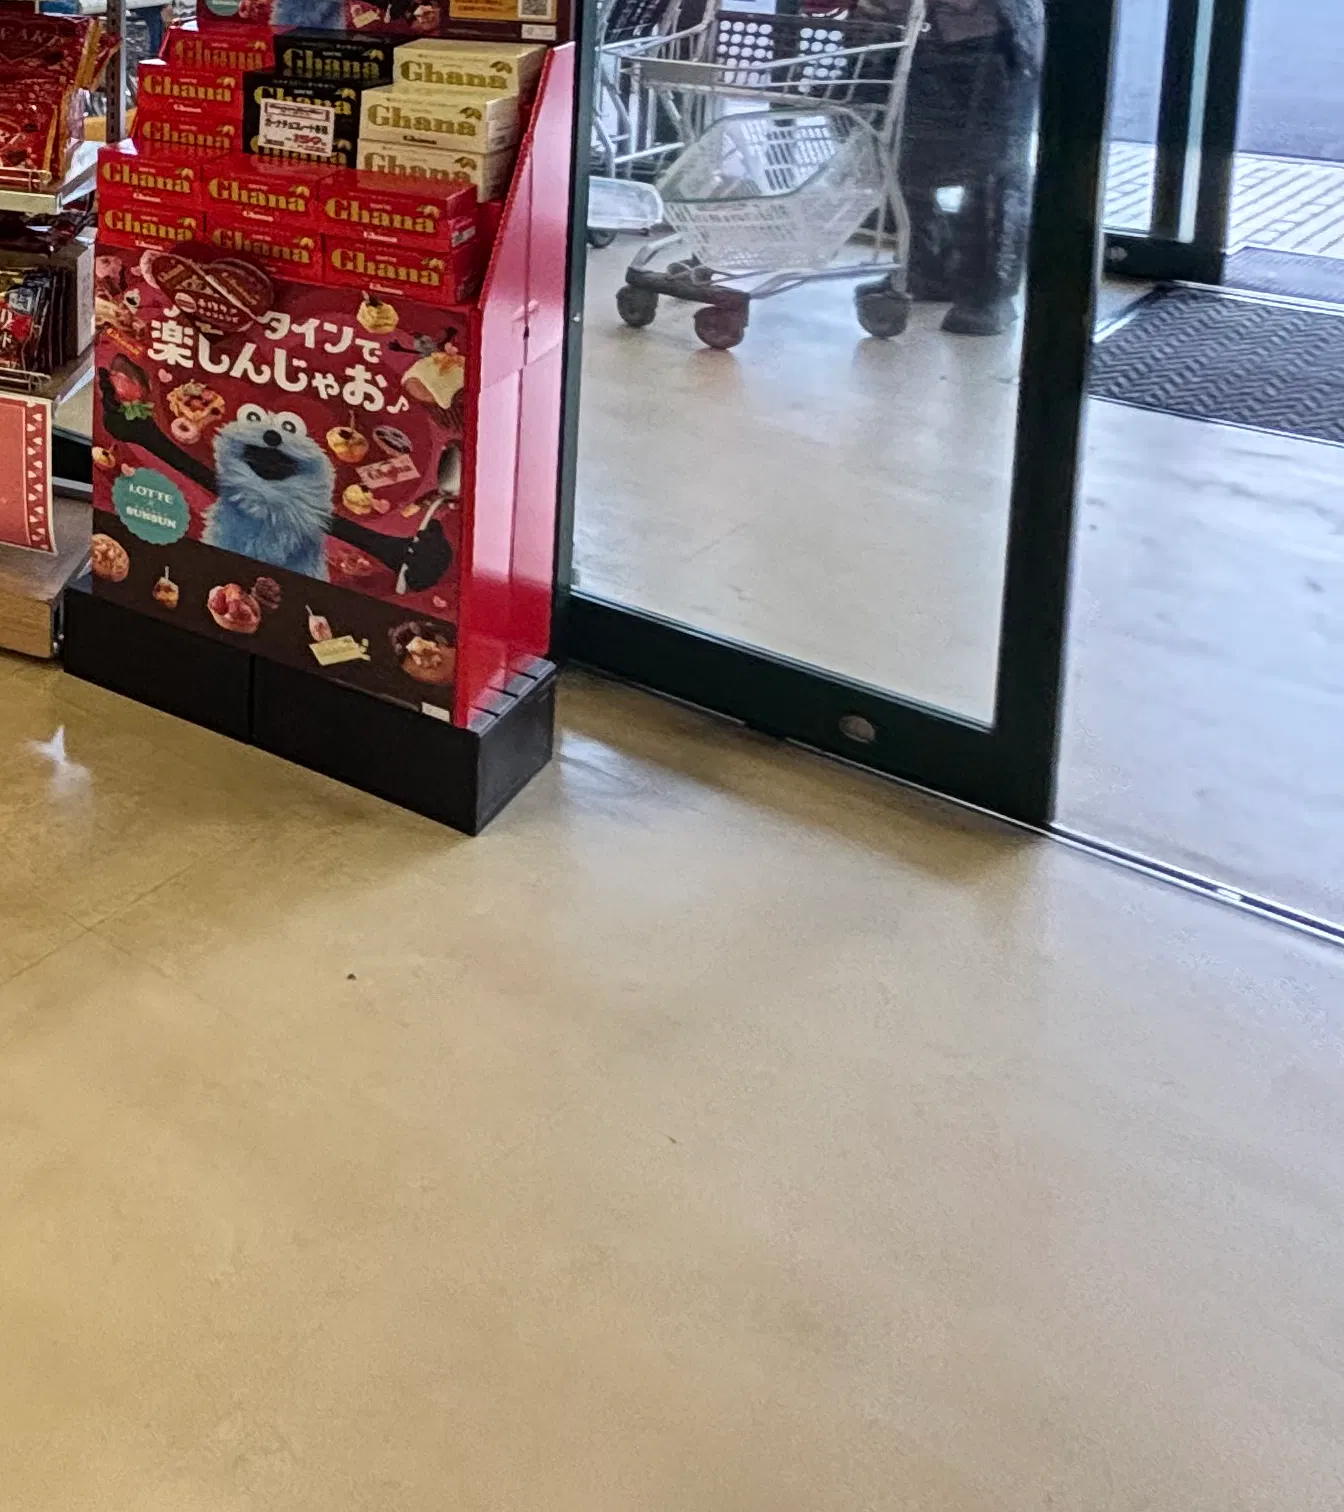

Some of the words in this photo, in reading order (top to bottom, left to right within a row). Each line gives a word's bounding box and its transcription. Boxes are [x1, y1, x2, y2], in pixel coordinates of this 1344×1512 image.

[174, 39, 263, 69] Ghana
[282, 47, 381, 76] Ghana
[142, 74, 233, 103] Ghana
[400, 59, 509, 90] Ghana
[142, 119, 232, 150] Ghana
[367, 103, 478, 138] Ghana
[101, 161, 192, 194] Ghana
[363, 151, 473, 183] Ghana
[208, 177, 307, 213] Ghana
[103, 209, 194, 242] Ghana
[324, 197, 436, 235] Ghana
[212, 227, 311, 265] Ghana
[330, 247, 441, 287] Ghana
[127, 483, 175, 506] LOTTE
